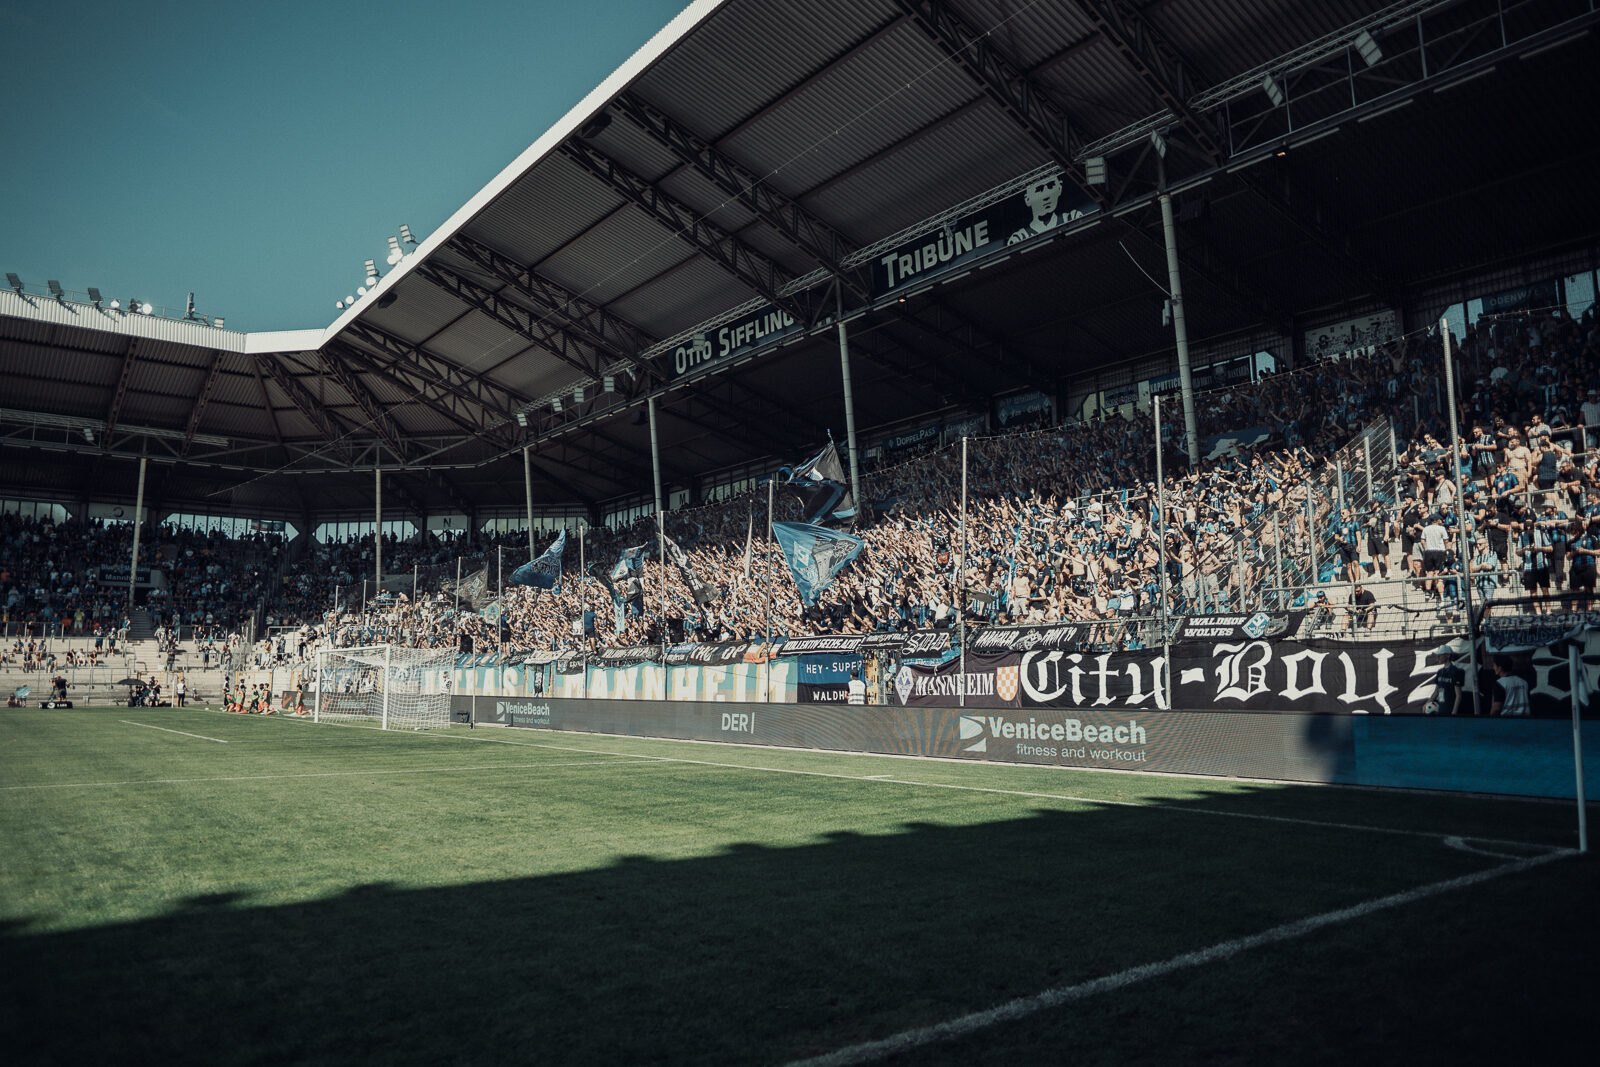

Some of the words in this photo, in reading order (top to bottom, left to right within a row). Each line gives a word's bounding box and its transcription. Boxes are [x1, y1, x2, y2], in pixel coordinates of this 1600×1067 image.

[881, 219, 990, 288] TRIBÜNE
[443, 517, 452, 528] N
[104, 573, 145, 582] Mannhim
[1188, 616, 1248, 627] WALDHOF
[1184, 627, 1235, 638] WOLVES
[806, 663, 823, 674] HEY
[915, 672, 994, 696] MANNHEIM
[812, 690, 846, 702] WALDH
[505, 701, 550, 716] VeniceBeach
[988, 716, 1148, 745] VeniceBeach
[1016, 743, 1058, 757] fitness
[1061, 746, 1086, 759] and
[1090, 748, 1148, 762] workout
